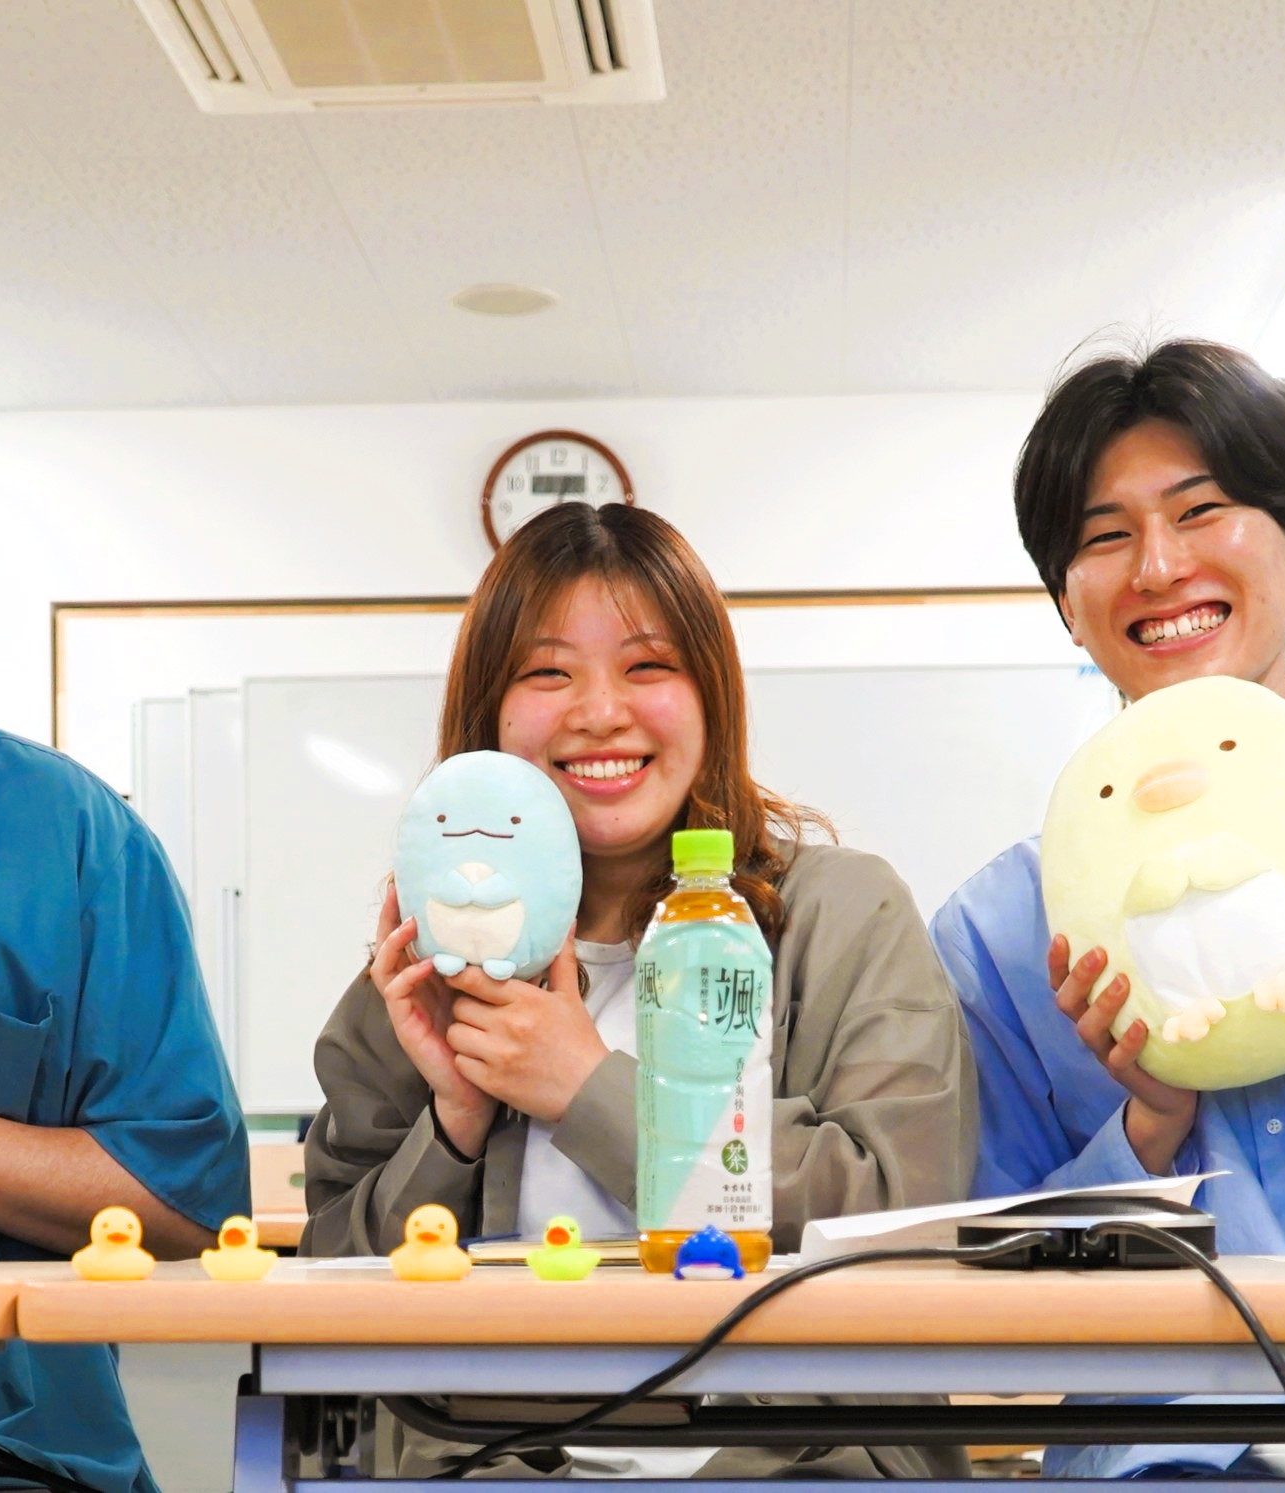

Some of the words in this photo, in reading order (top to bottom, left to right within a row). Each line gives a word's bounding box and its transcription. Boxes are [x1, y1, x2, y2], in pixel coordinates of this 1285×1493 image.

[550, 447, 568, 466] 12
[506, 475, 525, 493] 10
[638, 961, 663, 1009] 颯
[714, 967, 763, 1040] 颯
[724, 1142, 747, 1173] 茶
